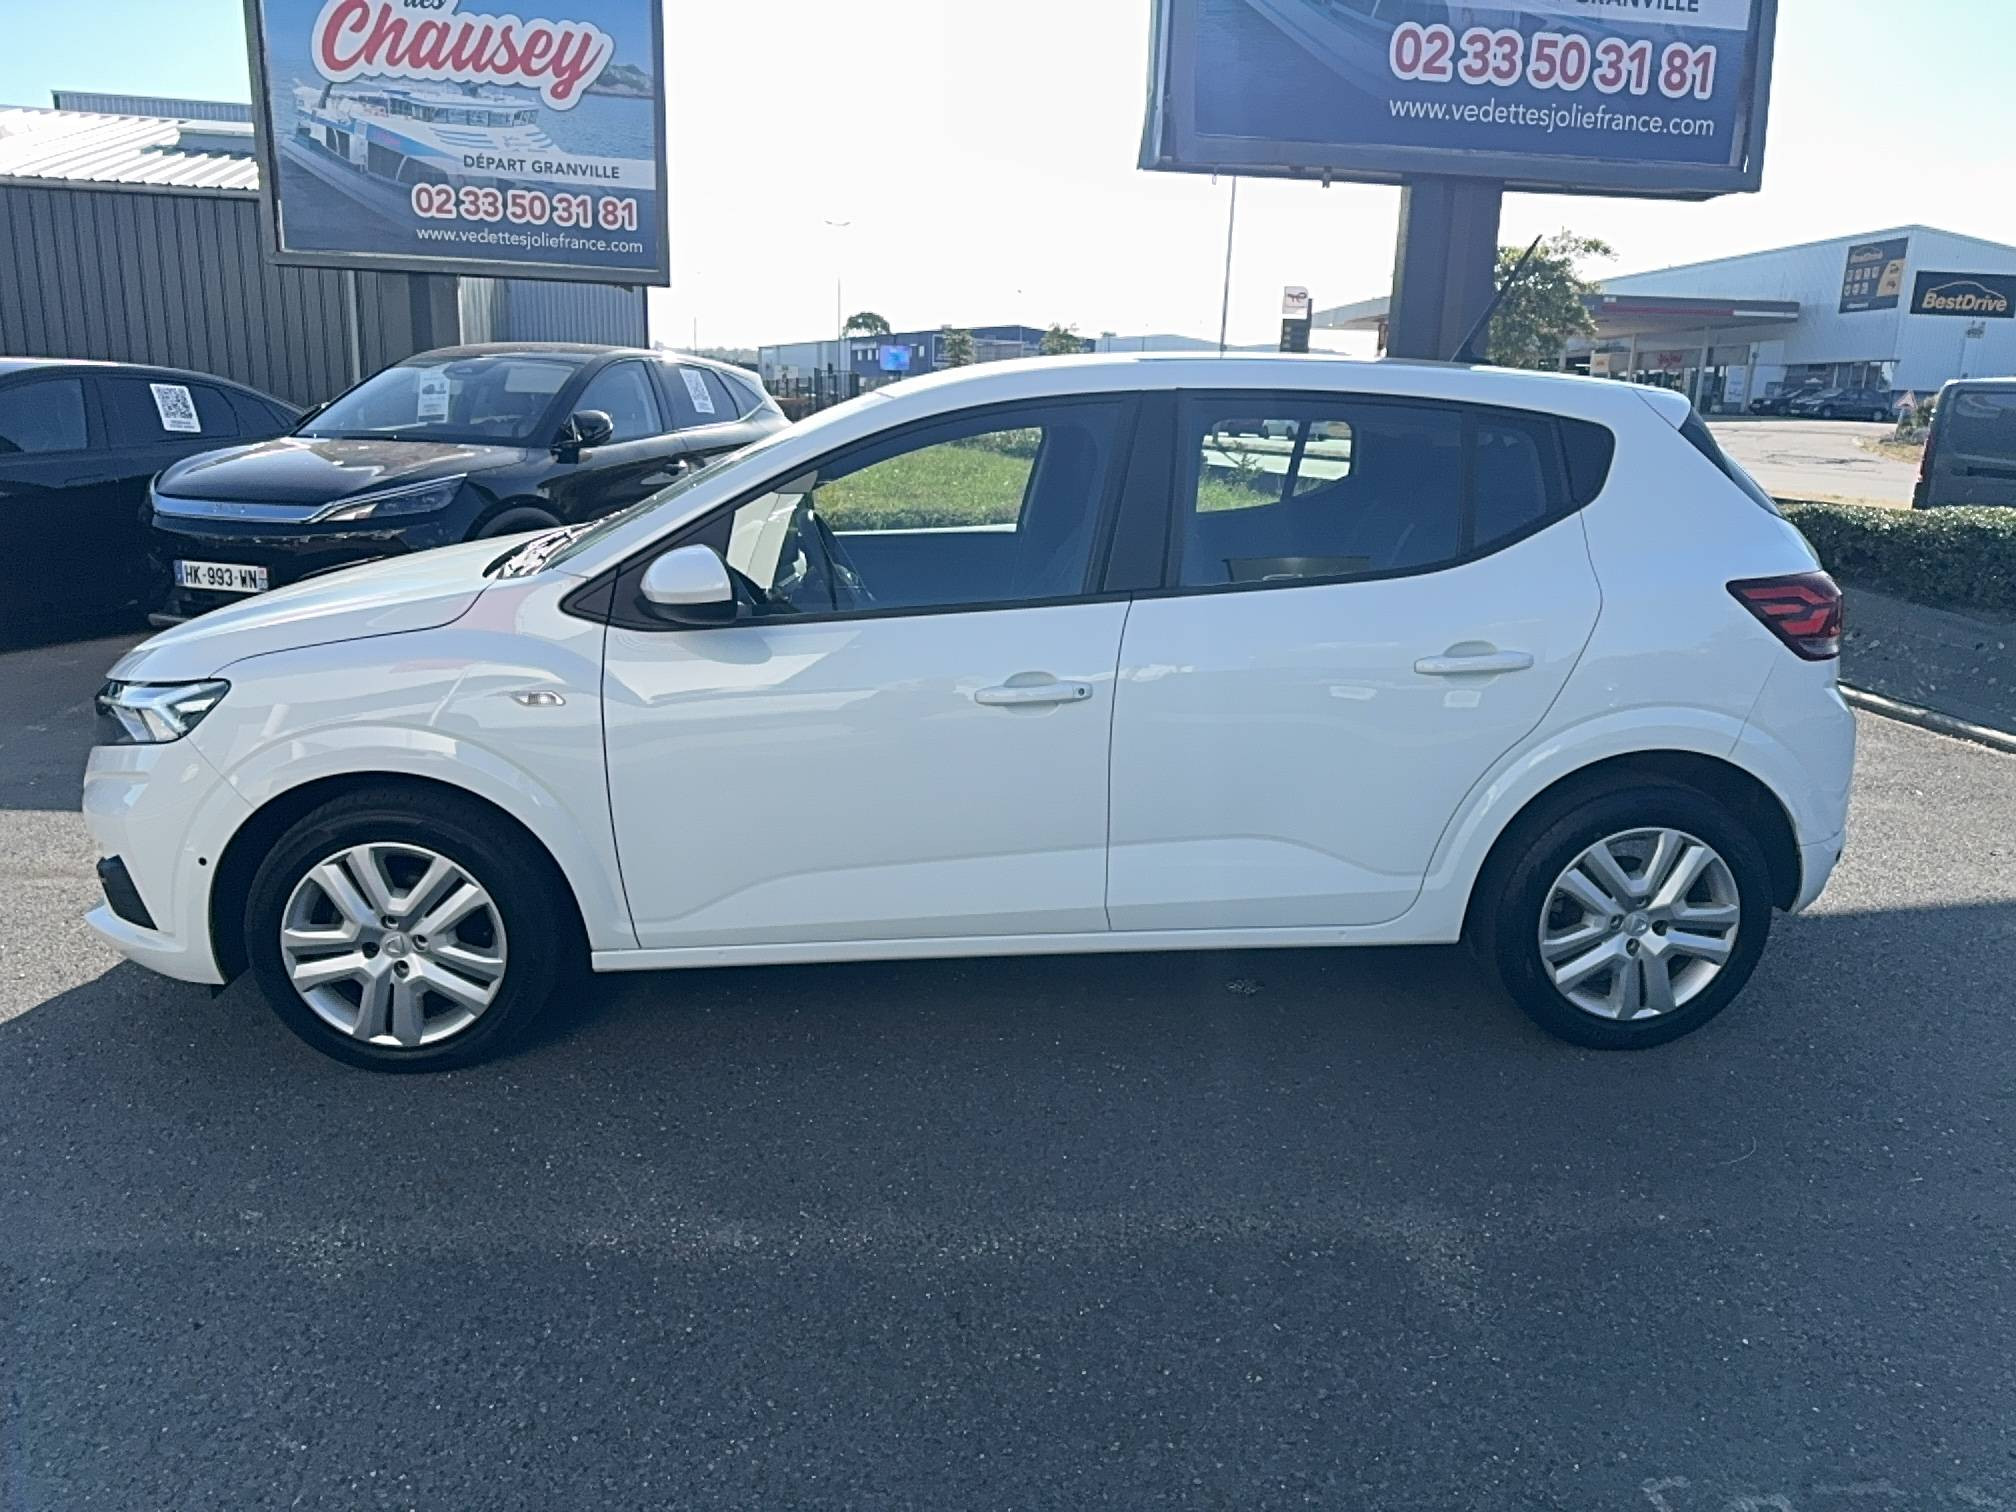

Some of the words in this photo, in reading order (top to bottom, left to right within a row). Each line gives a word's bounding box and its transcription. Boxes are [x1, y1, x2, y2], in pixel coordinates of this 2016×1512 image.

[321, 0, 605, 100] Chausey
[1393, 27, 1450, 77] 02
[1461, 31, 1520, 81] 33
[1529, 36, 1587, 86] 50
[1596, 41, 1649, 90] 31
[1661, 46, 1714, 95] 81
[1390, 98, 1715, 137] www.vedettesjoliefrance.com
[463, 153, 526, 173] DÉPART
[531, 160, 620, 179] GRANVILLE
[413, 185, 454, 216] 02
[461, 188, 501, 219] 33
[508, 192, 549, 222] 50
[554, 196, 592, 226] 31
[600, 199, 637, 229] 81
[416, 227, 643, 253] www.vedettesjoliefrance.com
[1922, 292, 2007, 311] BestDrive
[184, 565, 257, 588] HK-993-WN
